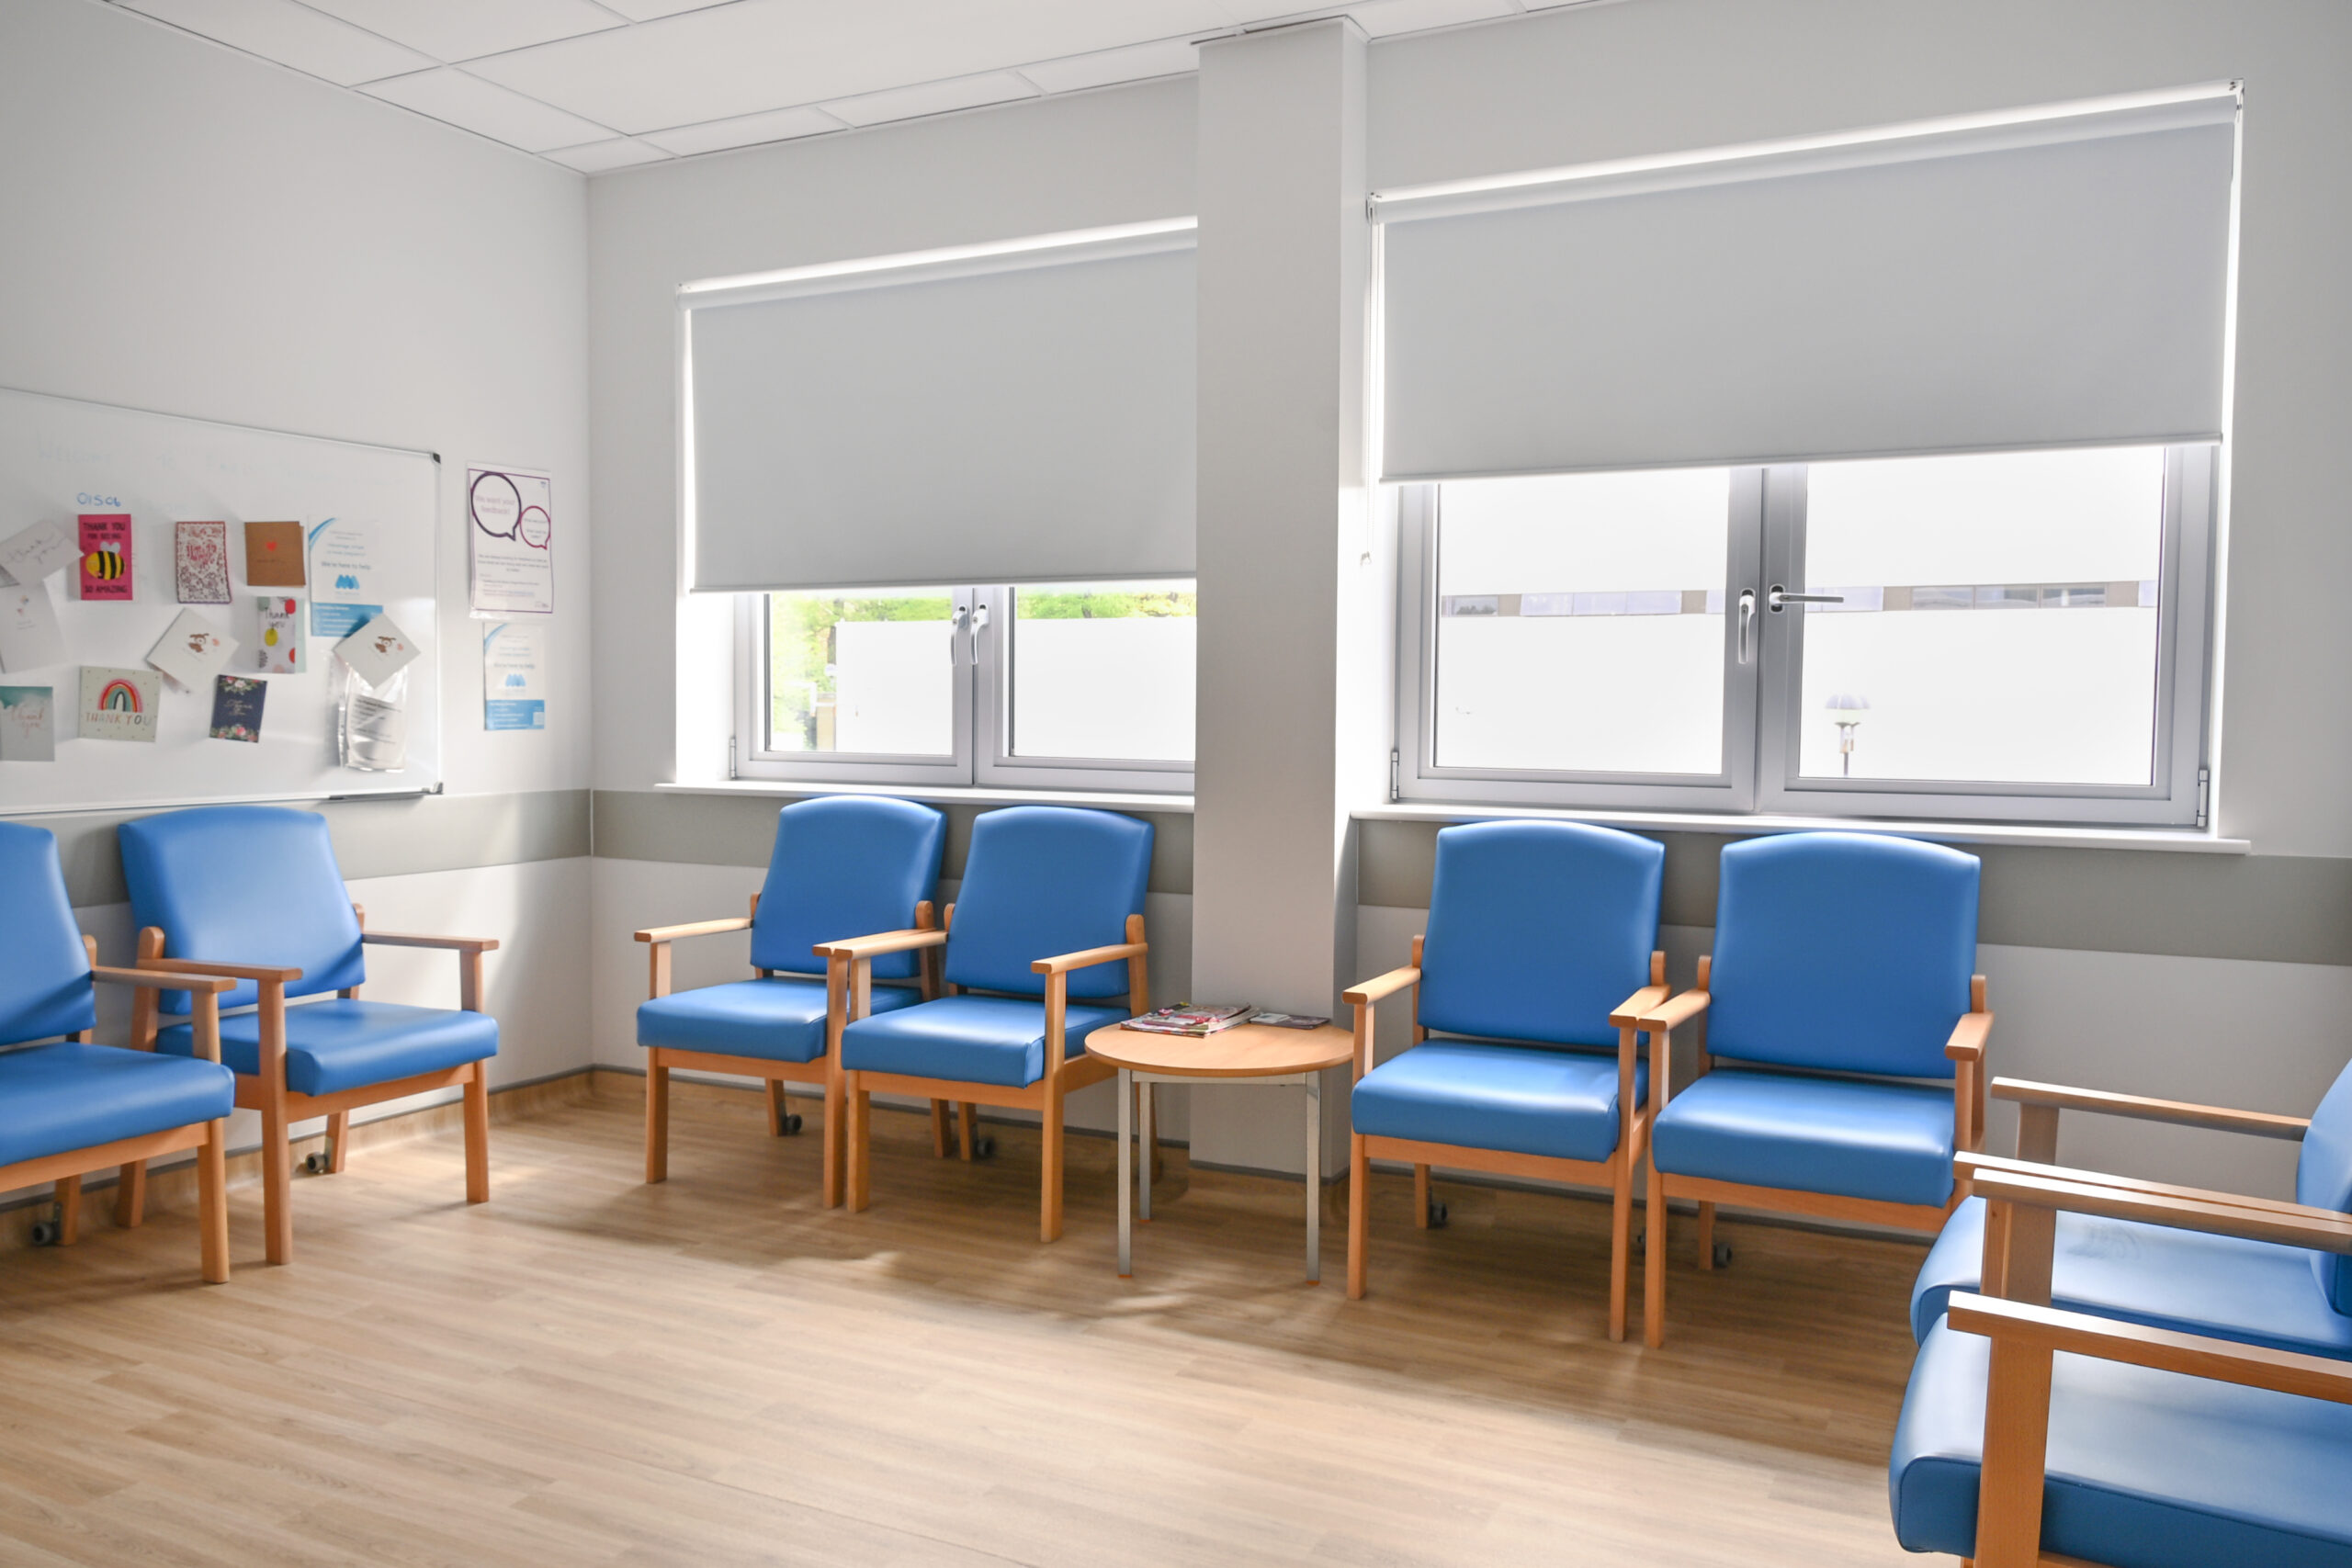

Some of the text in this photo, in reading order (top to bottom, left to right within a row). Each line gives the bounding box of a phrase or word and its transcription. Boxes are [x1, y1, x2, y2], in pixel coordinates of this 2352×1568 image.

[83, 522, 126, 531] THANK YOU
[96, 585, 128, 593] AMAZING
[264, 606, 290, 619] Thank
[85, 712, 152, 727] THANK YOU
